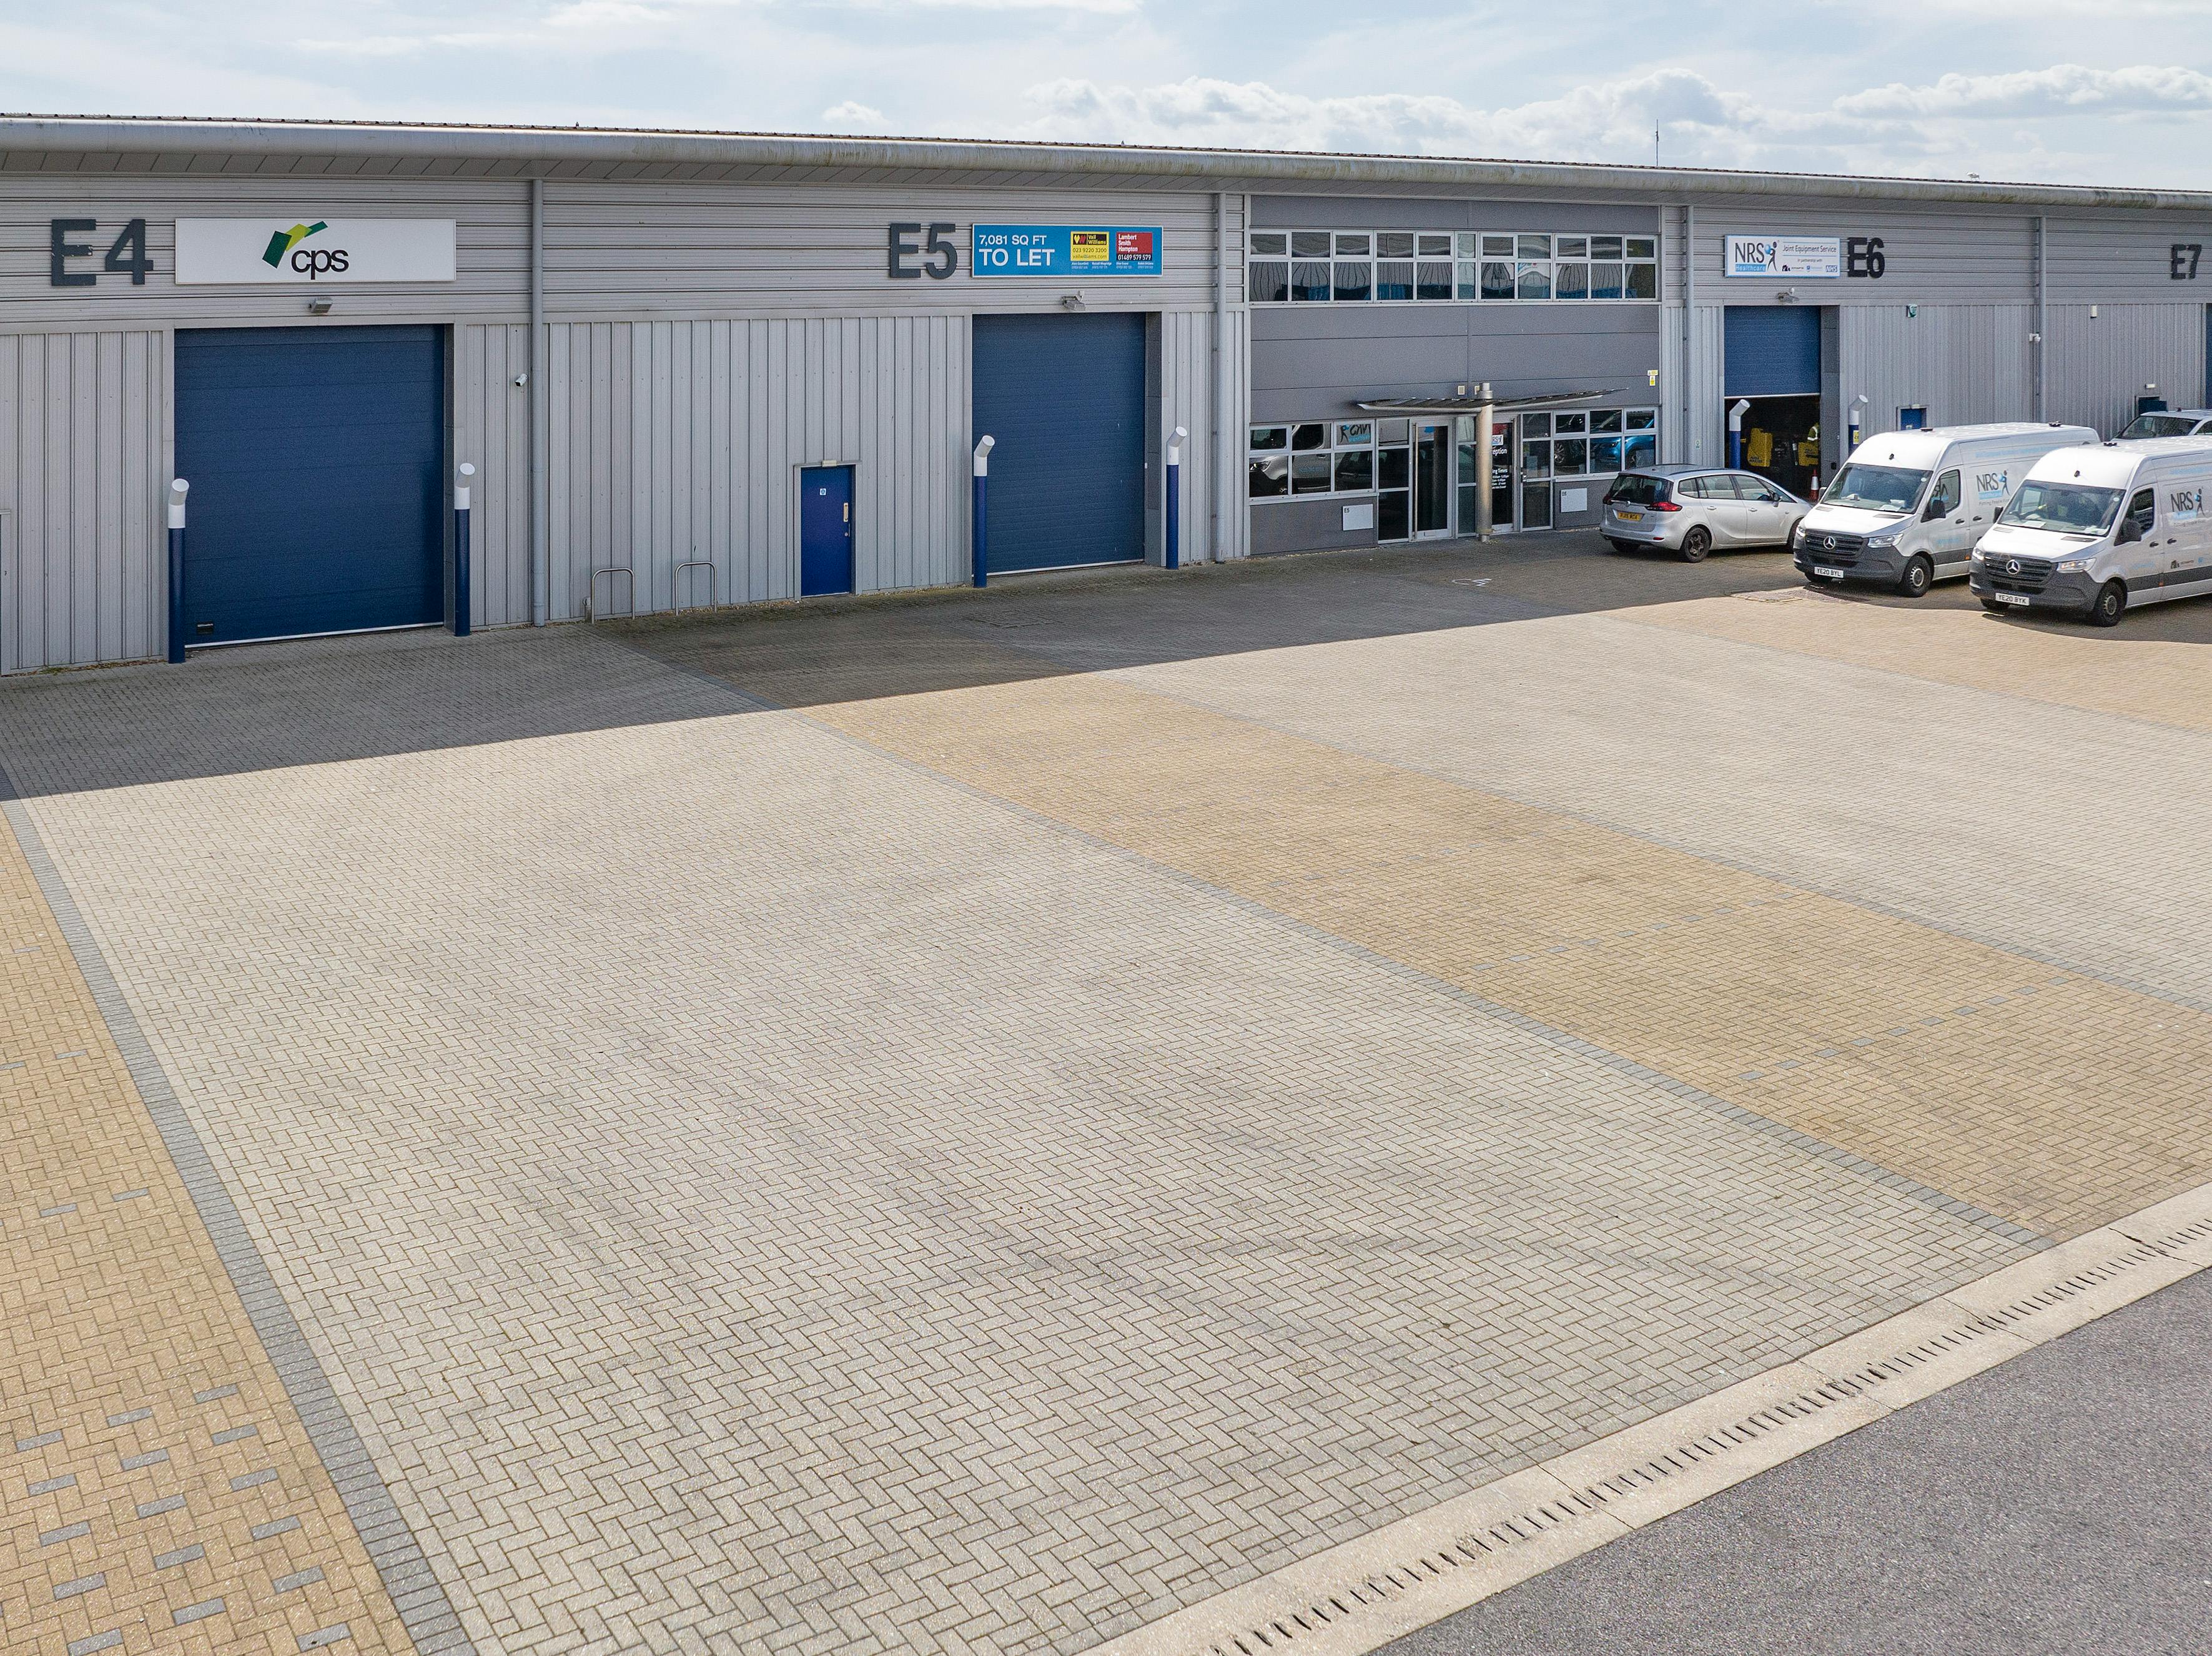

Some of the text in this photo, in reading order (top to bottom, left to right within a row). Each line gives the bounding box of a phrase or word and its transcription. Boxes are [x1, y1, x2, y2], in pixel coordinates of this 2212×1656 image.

[890, 223, 957, 280] E5
[979, 235, 1047, 247] 7,081 SQ FT
[1795, 245, 1820, 254] Equipment
[51, 219, 154, 286] E4
[979, 249, 1055, 266] TO LET
[1735, 242, 1765, 264] NRS
[1848, 237, 1885, 278] E6
[2171, 244, 2202, 279] E7
[291, 249, 348, 280] cps
[1976, 473, 1999, 492] NRS
[2170, 491, 2194, 512] NRS
[1998, 594, 2013, 603] YE20
